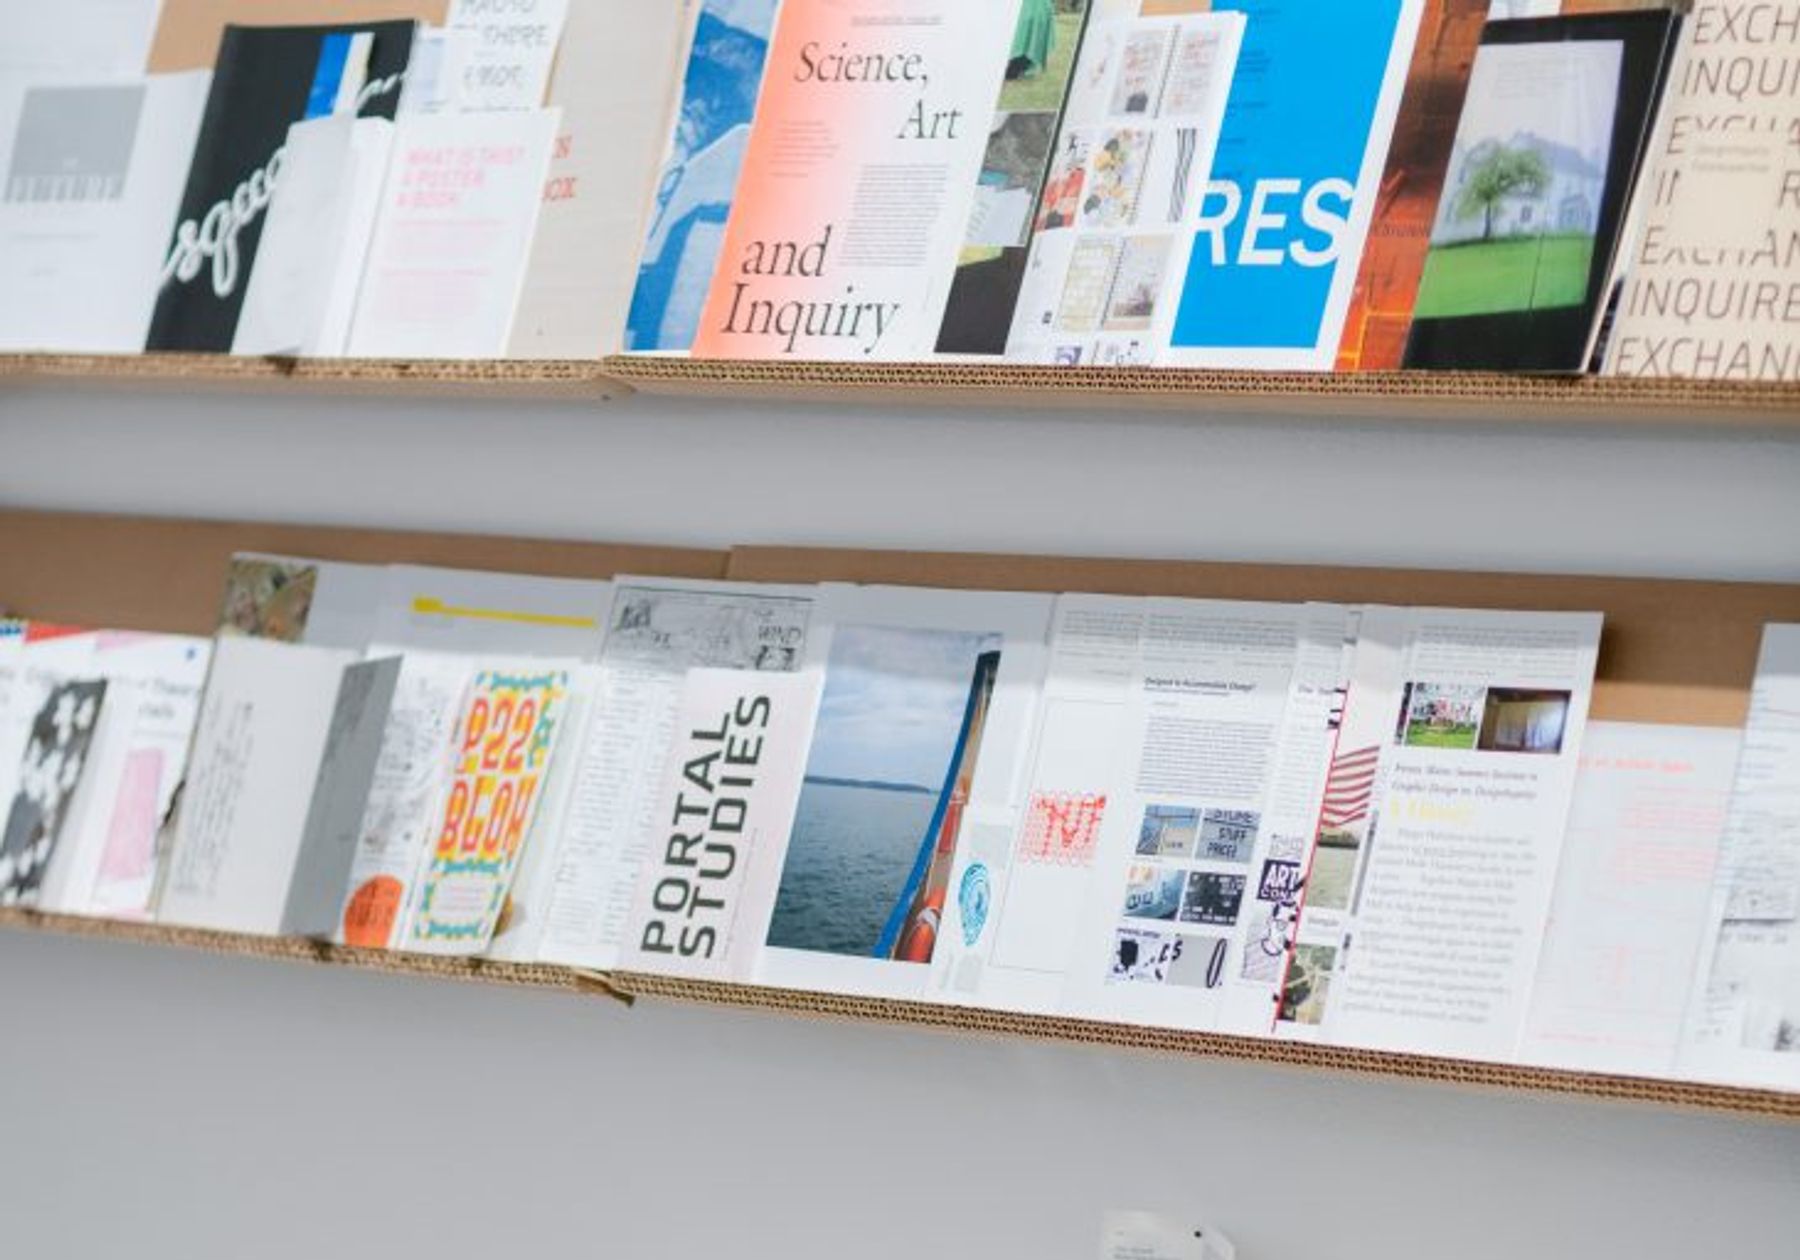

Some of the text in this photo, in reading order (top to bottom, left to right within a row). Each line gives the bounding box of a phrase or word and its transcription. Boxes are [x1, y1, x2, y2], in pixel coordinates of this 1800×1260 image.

[794, 41, 928, 89] Science,
[896, 98, 963, 140] Art
[1192, 177, 1354, 268] RES
[741, 224, 832, 277] and
[721, 281, 900, 354] Inquiry
[1628, 277, 1800, 326] INQUIRE
[1616, 337, 1800, 380] EXCHAN
[641, 712, 730, 954] PORTAL
[678, 695, 771, 960] STUDIES
